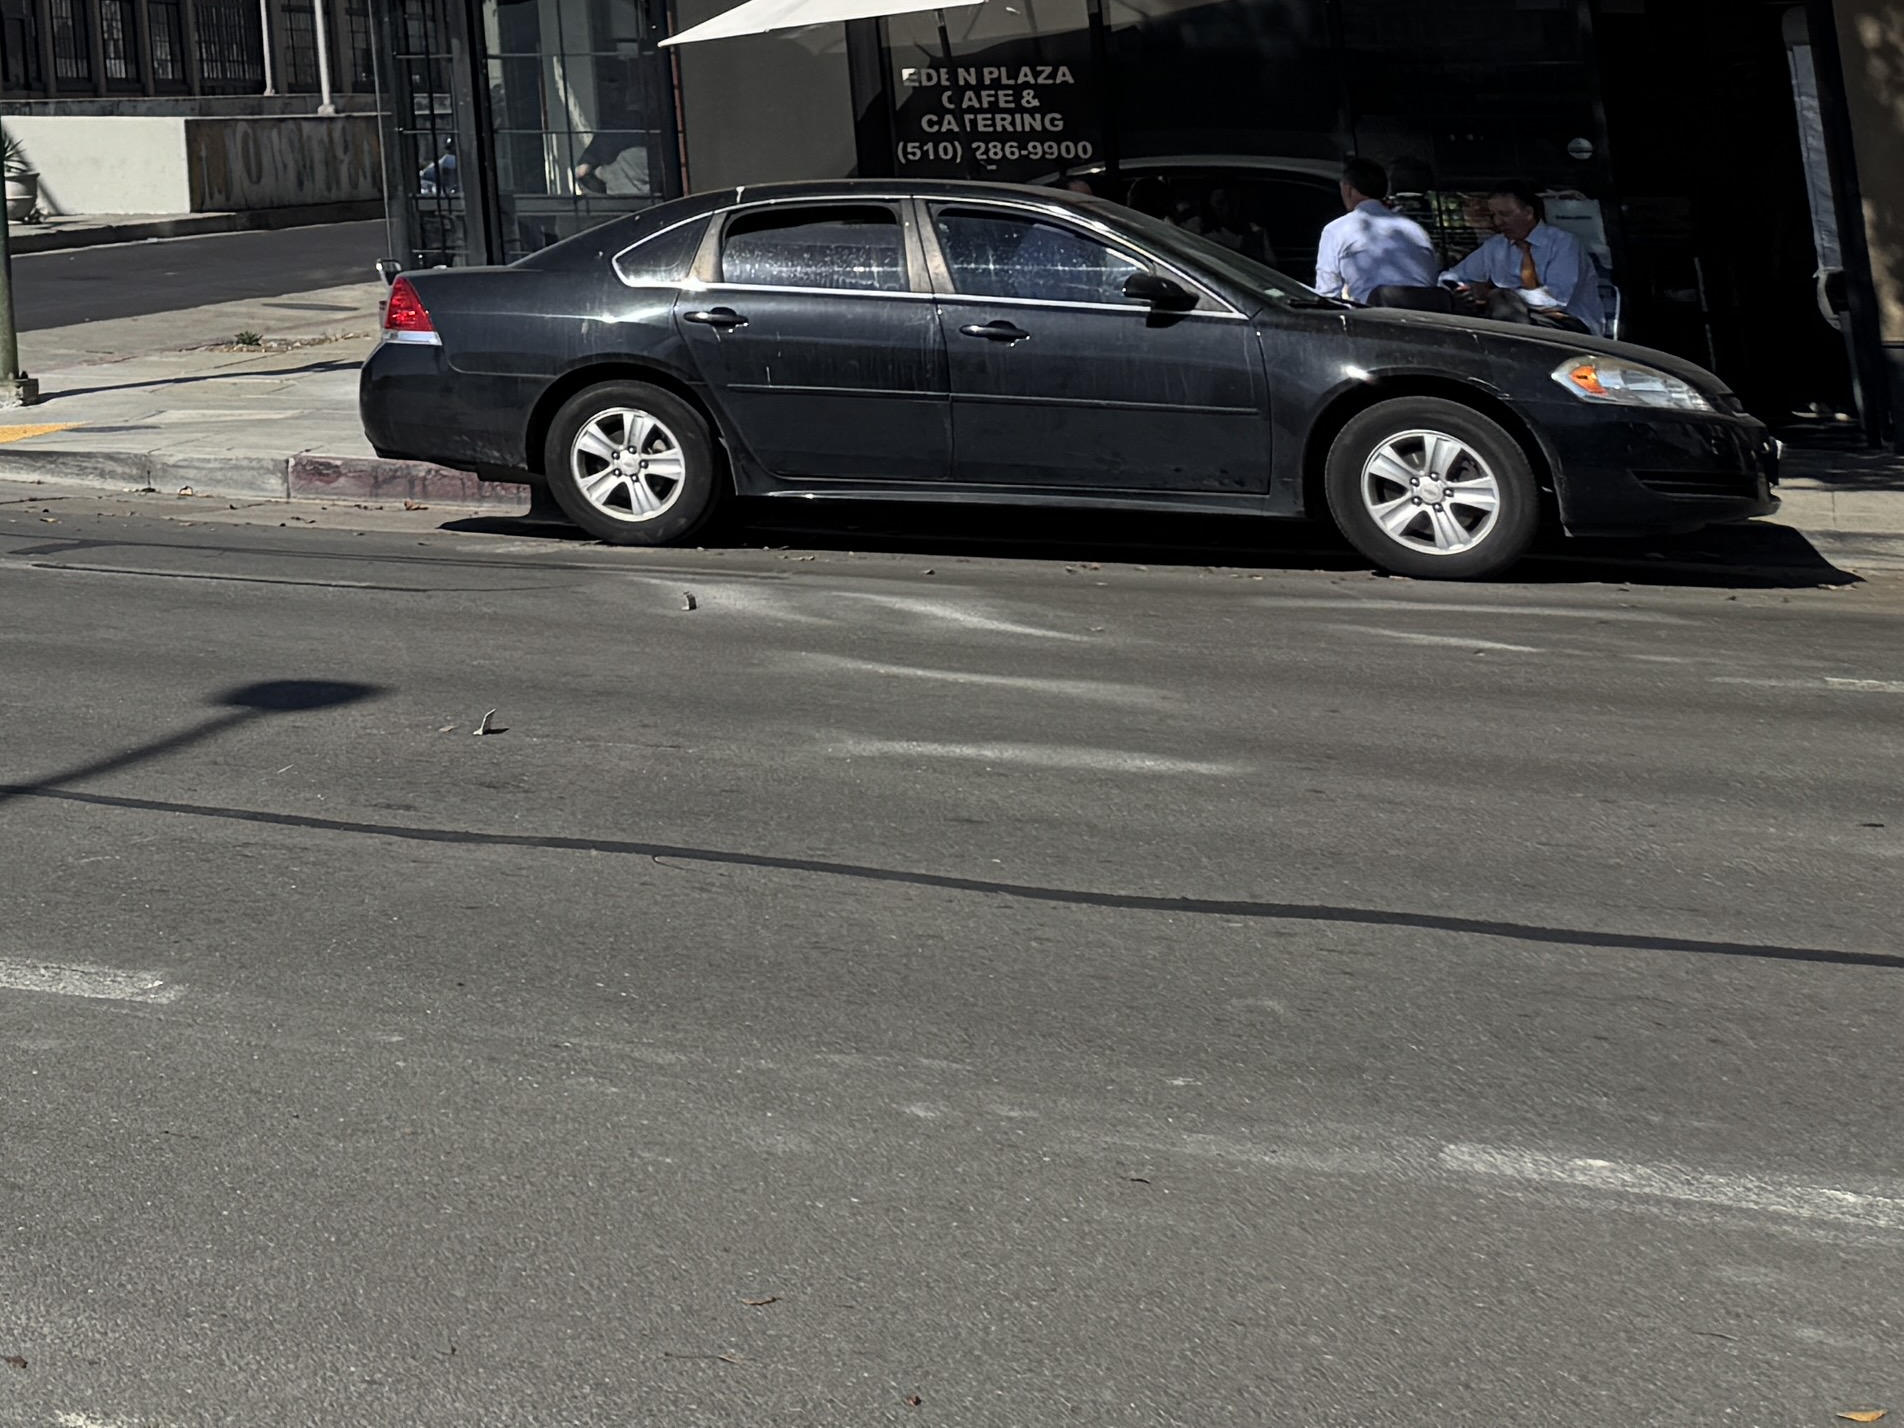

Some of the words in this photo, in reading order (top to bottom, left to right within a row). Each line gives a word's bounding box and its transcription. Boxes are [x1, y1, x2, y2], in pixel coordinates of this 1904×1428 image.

[901, 67, 977, 86] EDEN
[983, 66, 1075, 85] PLAZA
[942, 90, 1016, 108] CAFE
[1021, 89, 1040, 108] &
[921, 113, 1064, 132] CATERING
[897, 141, 962, 164] (510)
[971, 141, 1092, 160] 286-9900
